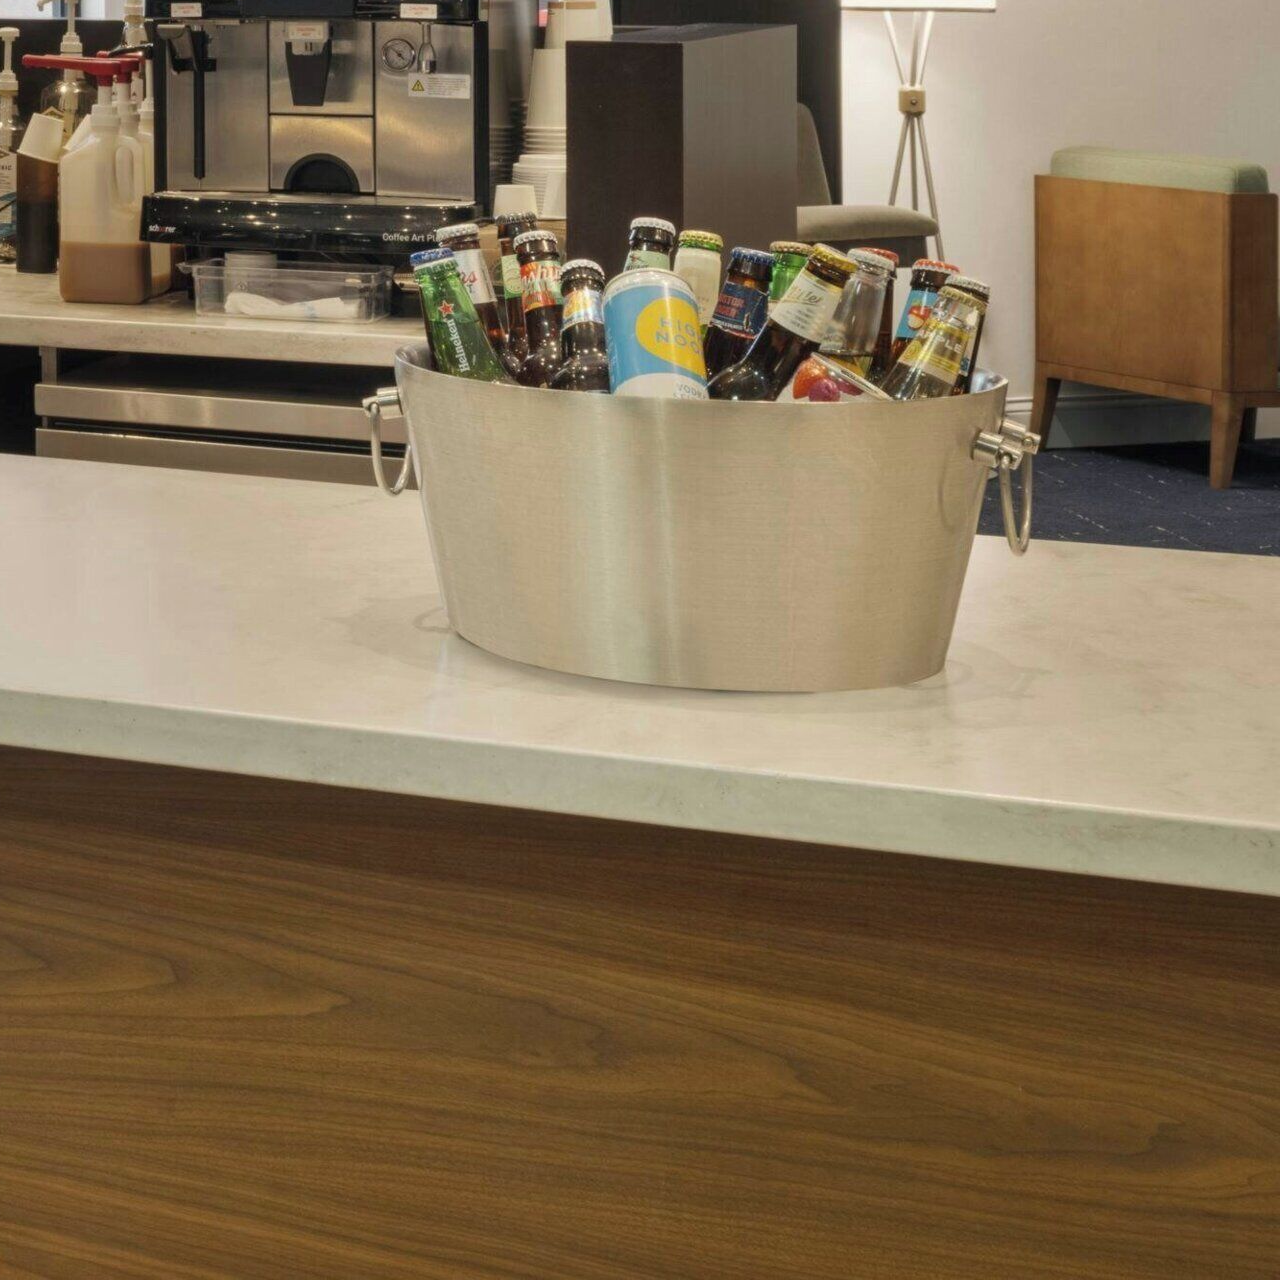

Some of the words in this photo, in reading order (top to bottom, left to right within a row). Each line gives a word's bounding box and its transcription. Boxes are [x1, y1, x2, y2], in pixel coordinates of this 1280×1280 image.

[382, 232, 410, 243] Coffee
[411, 233, 425, 242] Art
[444, 318, 471, 373] Heineken
